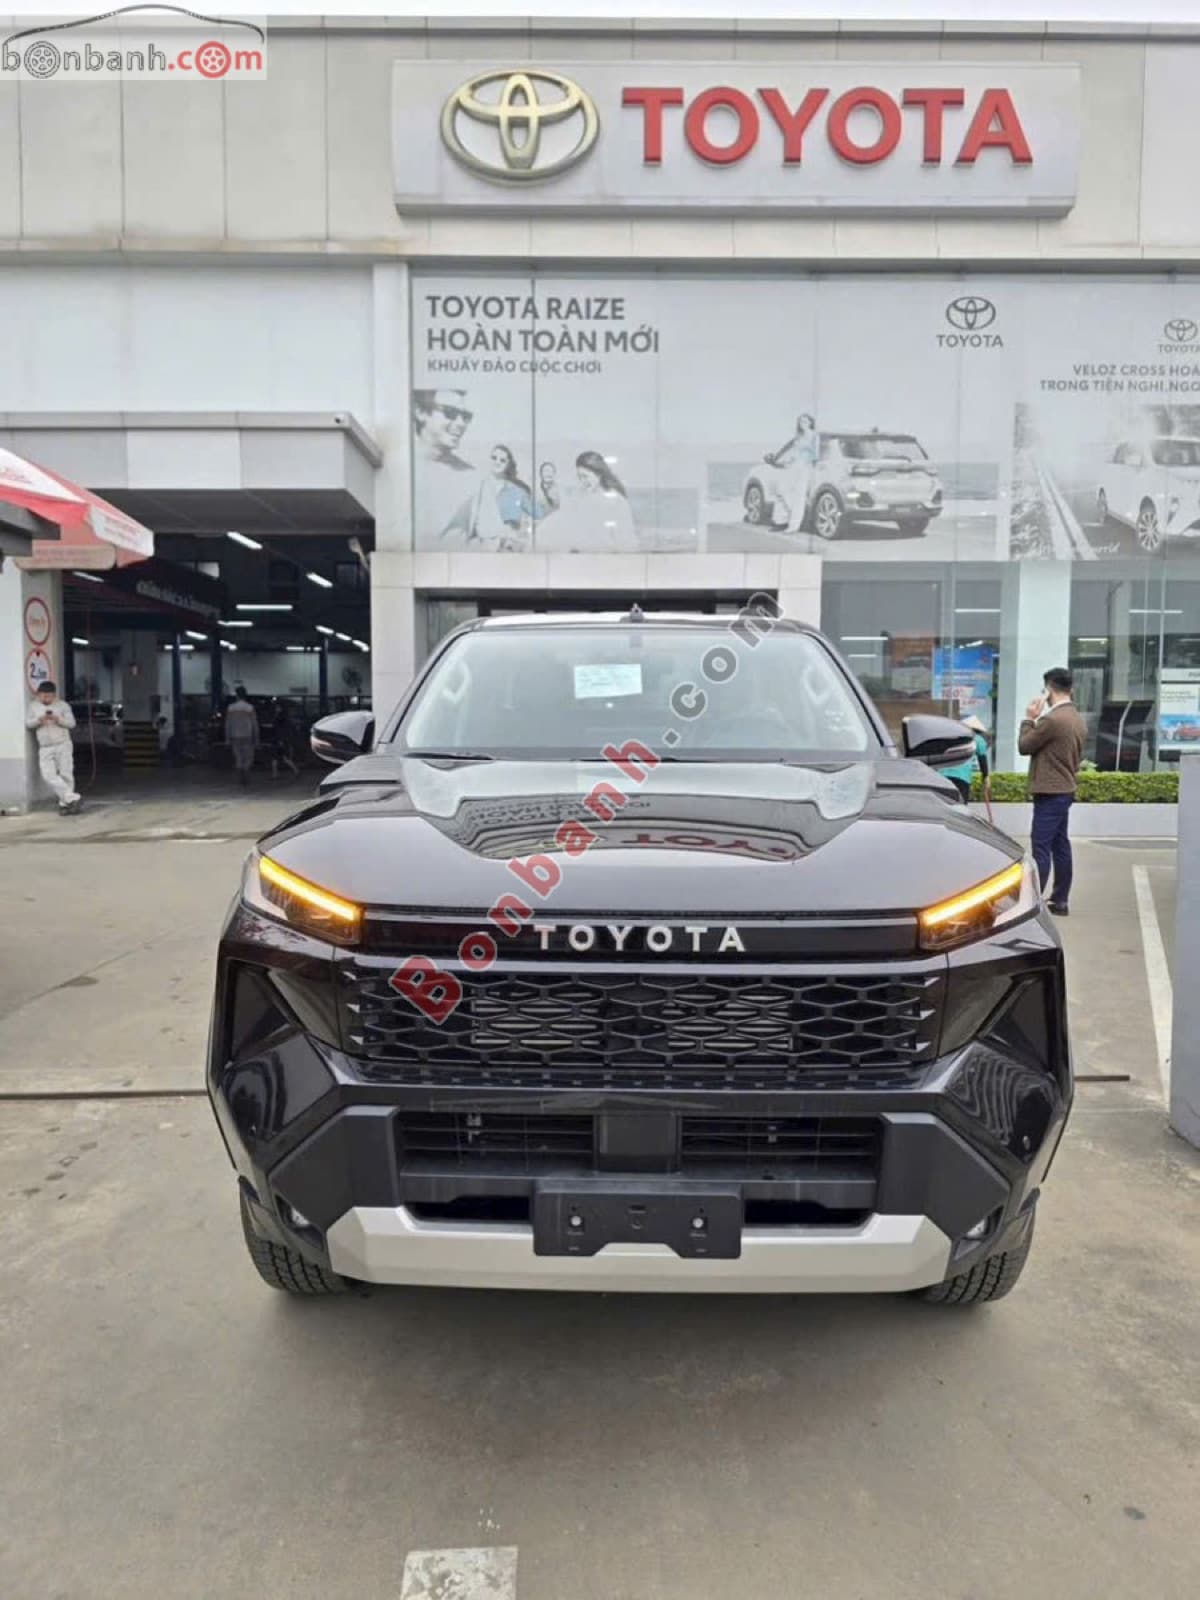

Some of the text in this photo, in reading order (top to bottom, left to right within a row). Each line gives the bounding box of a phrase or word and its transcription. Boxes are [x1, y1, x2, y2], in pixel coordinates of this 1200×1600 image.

[622, 86, 1033, 167] TOYOTA
[426, 296, 625, 320] TOYOTA RAIZE
[428, 323, 660, 353] HOÀN TOÀN MỚI
[936, 334, 1003, 348] TOYOTA
[1073, 364, 1117, 376] VELOZ
[1120, 364, 1166, 377] CROSS
[533, 924, 747, 953] TOYOTA
